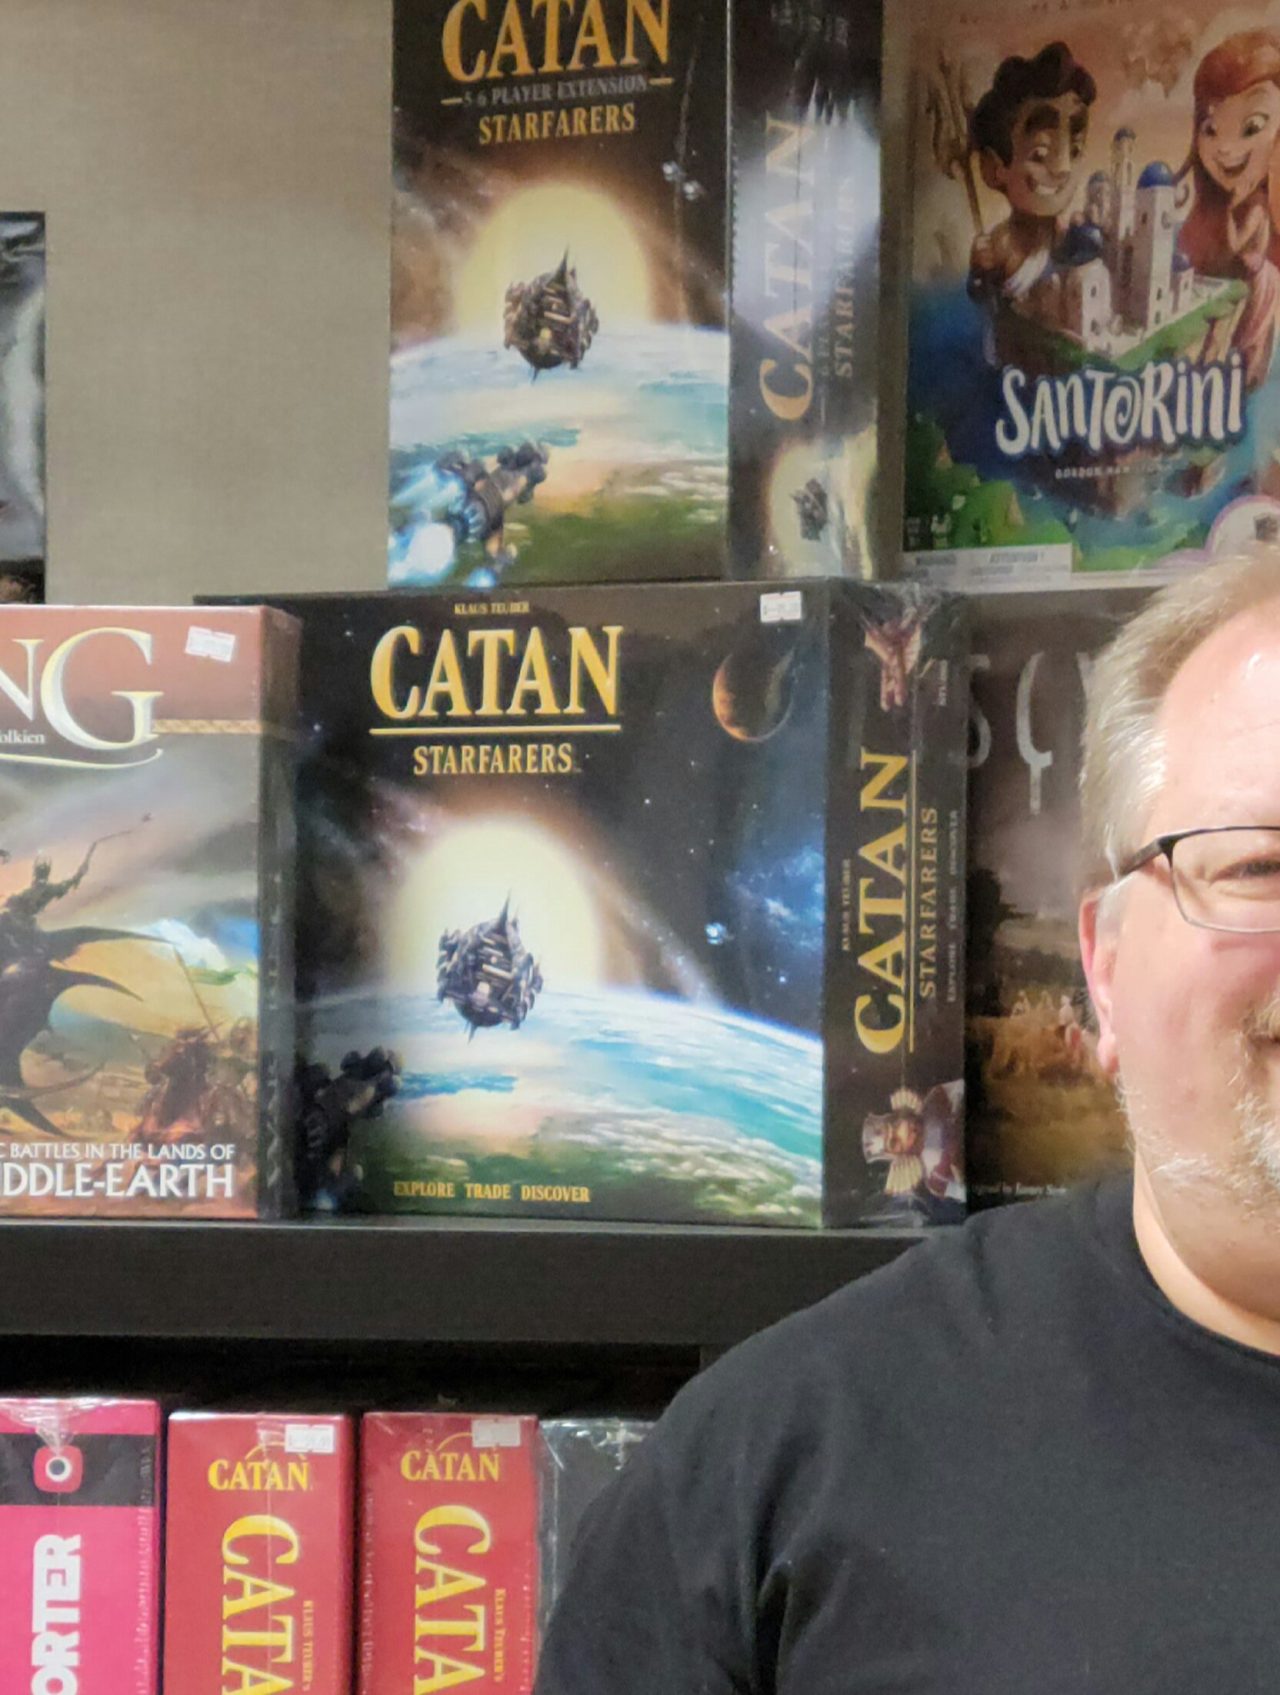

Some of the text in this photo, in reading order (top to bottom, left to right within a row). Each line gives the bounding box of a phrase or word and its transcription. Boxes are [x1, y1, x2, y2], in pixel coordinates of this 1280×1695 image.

[441, 0, 670, 82] CATAN
[492, 82, 551, 105] PLAYER
[557, 74, 648, 99] EXTENSION
[478, 102, 636, 146] STARFARERS
[759, 111, 815, 421] CATAN
[369, 625, 624, 720] CATAN
[413, 742, 574, 776] STARFARERS
[854, 746, 908, 1054] CATAN
[919, 807, 938, 998] STARFARERS
[10, 1143, 80, 1161] BATTLES
[86, 1143, 105, 1160] IN
[109, 1143, 142, 1160] THE
[148, 1144, 206, 1160] LANDS
[210, 1144, 236, 1161] OF
[394, 1180, 591, 1203] EXPLORE TRADE DISCOVER
[207, 1459, 309, 1491] CATAN
[400, 1449, 500, 1481] CATAN
